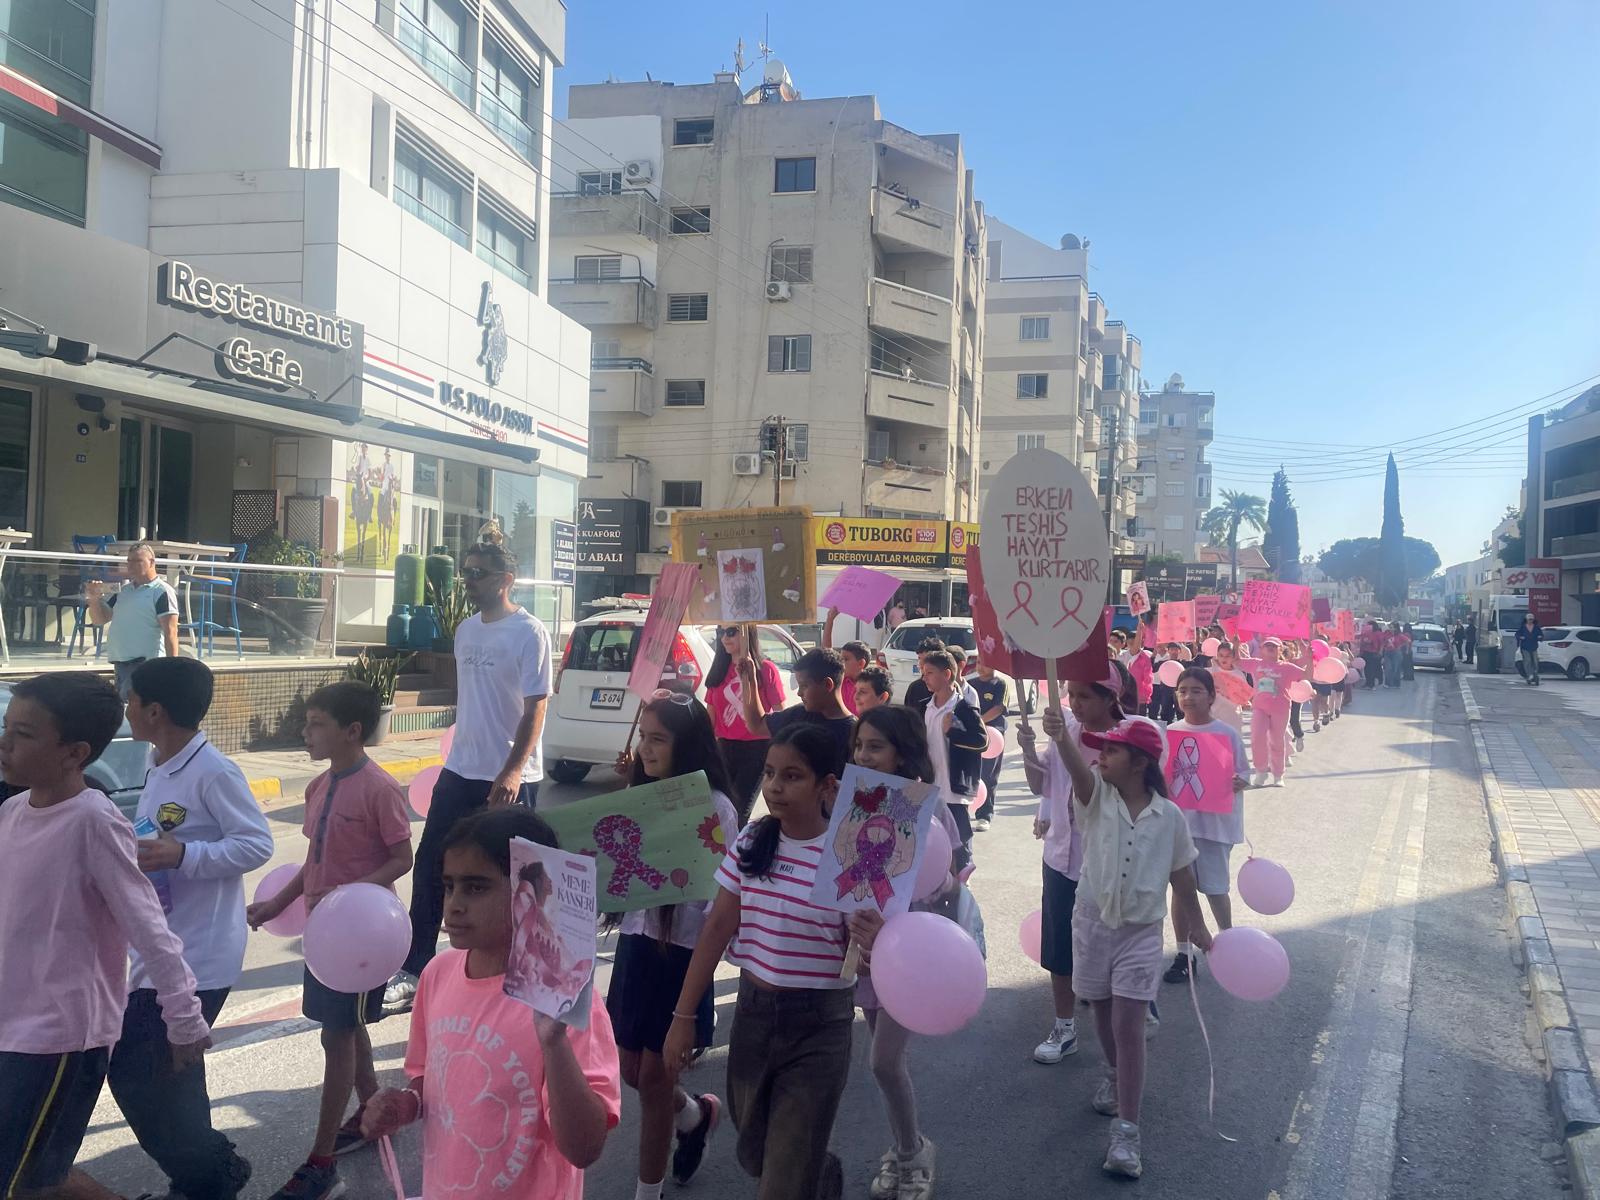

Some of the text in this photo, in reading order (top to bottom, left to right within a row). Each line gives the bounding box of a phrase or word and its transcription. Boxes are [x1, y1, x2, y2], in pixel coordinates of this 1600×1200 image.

[172, 261, 352, 349] Restaurant
[229, 337, 303, 388] Cafe
[439, 381, 466, 411] U.S.
[466, 392, 502, 423] POLO
[1016, 486, 1072, 511] ERKEN
[581, 529, 621, 538] KUAFÖRÜ
[849, 526, 913, 543] TUBORG
[588, 553, 624, 562] ABALI
[828, 552, 937, 564] DEREBOYU ATLAR MARKET
[1007, 536, 1066, 559] HAYAT
[561, 872, 591, 894] MEME
[475, 1024, 505, 1051] OF
[503, 1051, 539, 1126] YOUR
[491, 1136, 535, 1191] LIFE
